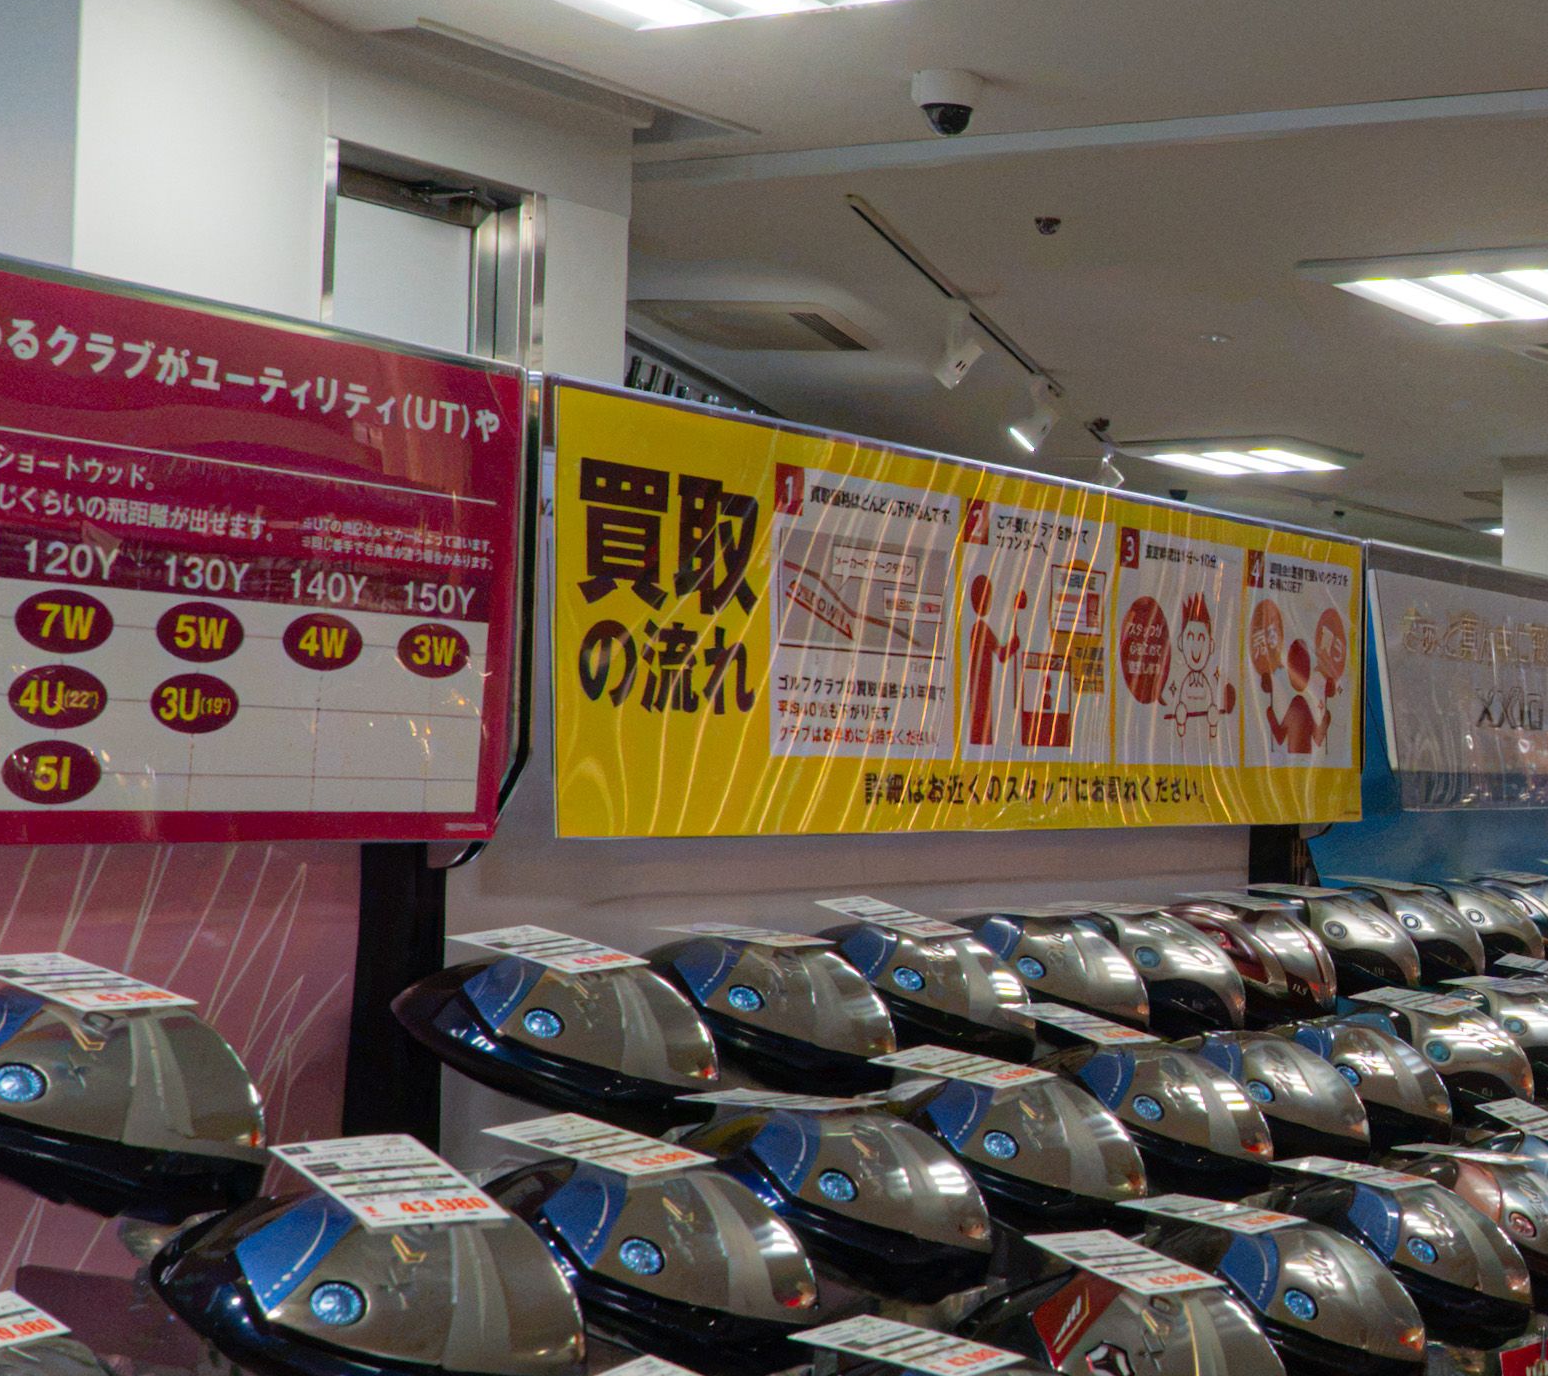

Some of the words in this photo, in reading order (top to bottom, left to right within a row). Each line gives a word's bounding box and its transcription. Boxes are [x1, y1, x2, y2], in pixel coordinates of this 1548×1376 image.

[784, 475, 795, 507] 1
[578, 457, 759, 615] 買取
[1125, 536, 1135, 563] 3
[23, 540, 122, 582] 120Y
[164, 554, 250, 594] 130Y
[290, 571, 369, 606] 140Y
[404, 580, 476, 616] 150Y
[35, 601, 94, 641] 7W
[173, 613, 228, 650] 5W
[298, 625, 349, 659] 4W
[411, 635, 457, 667] 3W
[579, 618, 755, 716] の流れ
[33, 755, 71, 791] 5I
